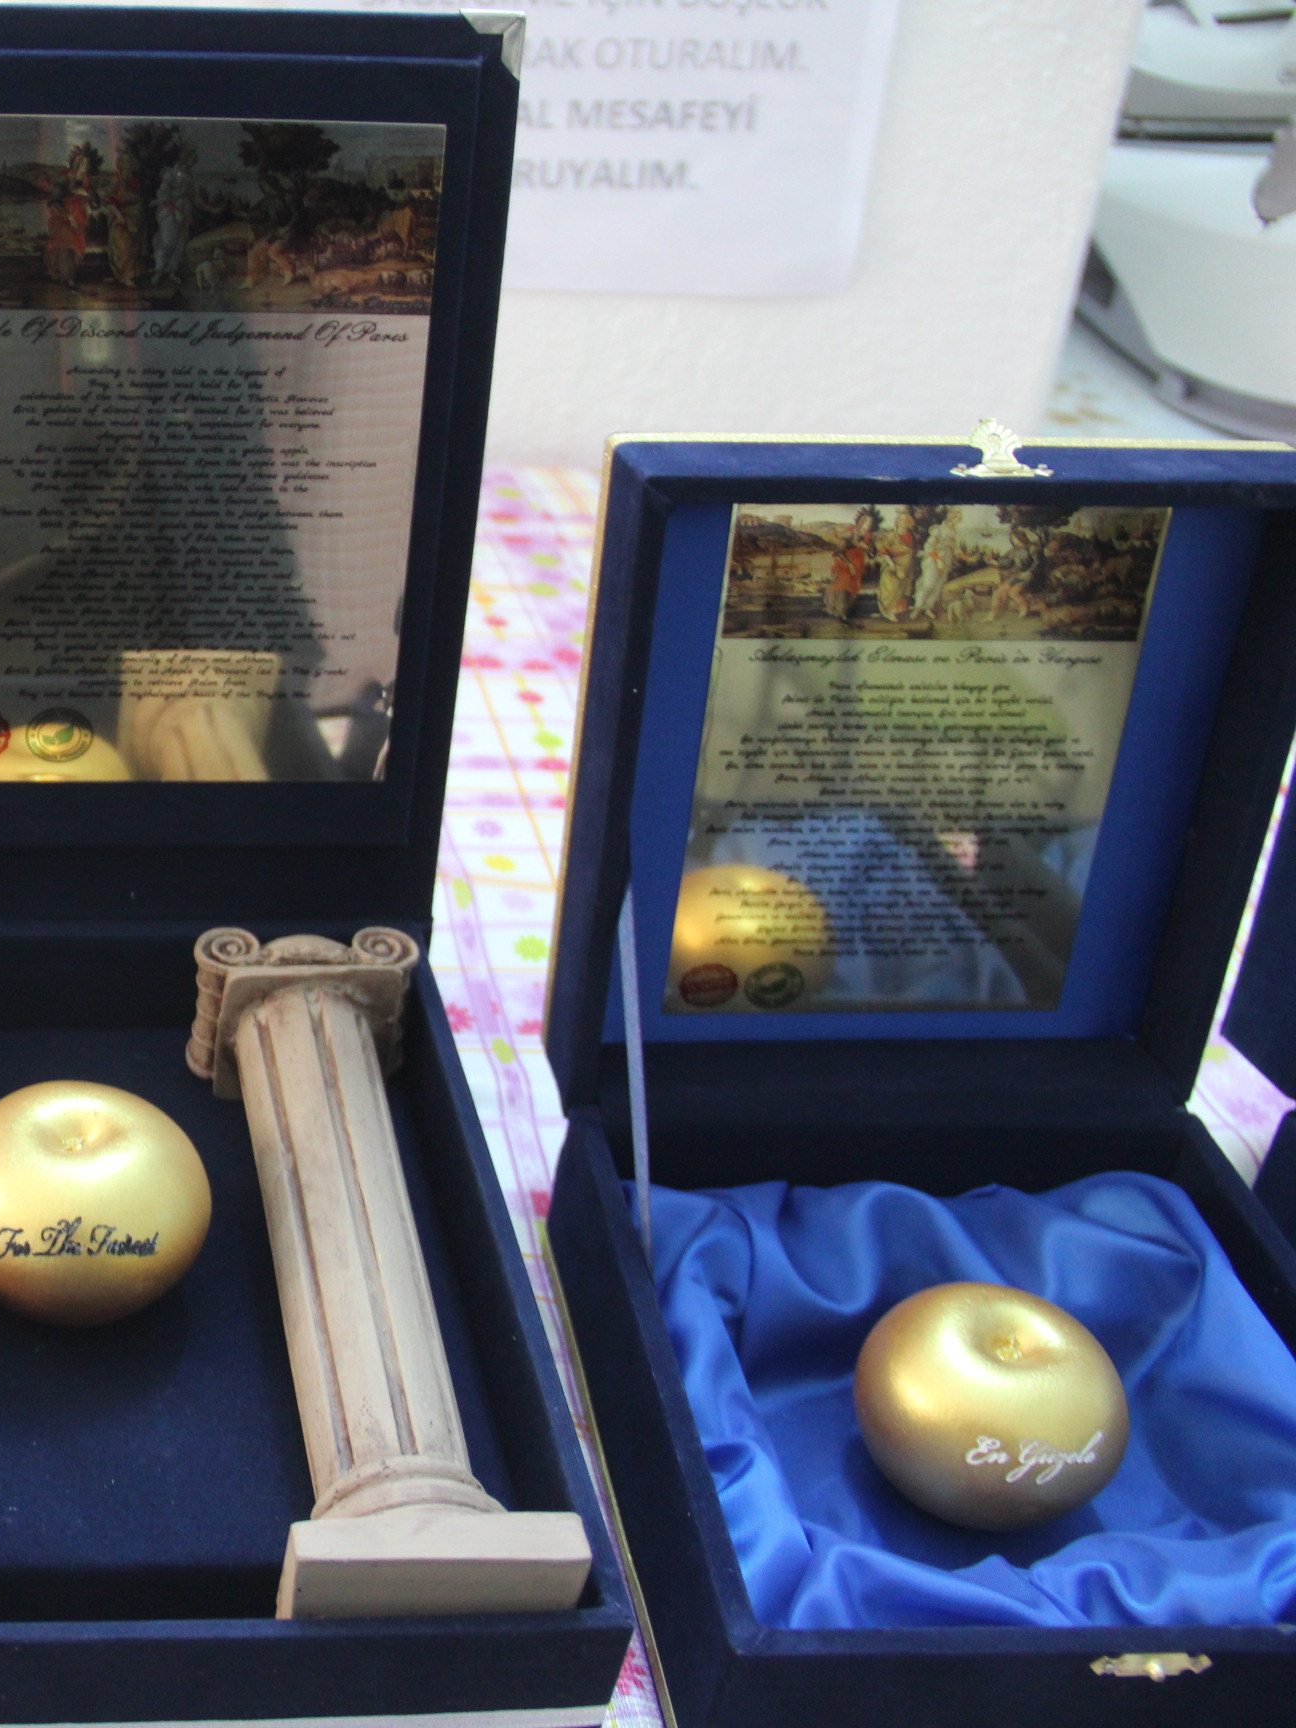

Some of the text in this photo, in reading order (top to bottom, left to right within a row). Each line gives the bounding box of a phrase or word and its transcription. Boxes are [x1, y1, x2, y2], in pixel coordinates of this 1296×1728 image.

[594, 36, 810, 72] OTURALIM.
[566, 94, 758, 132] MESAFEYİ
[21, 316, 56, 344] Of
[144, 317, 199, 339] And
[314, 319, 352, 347] Of
[965, 1435, 1010, 1465] En
